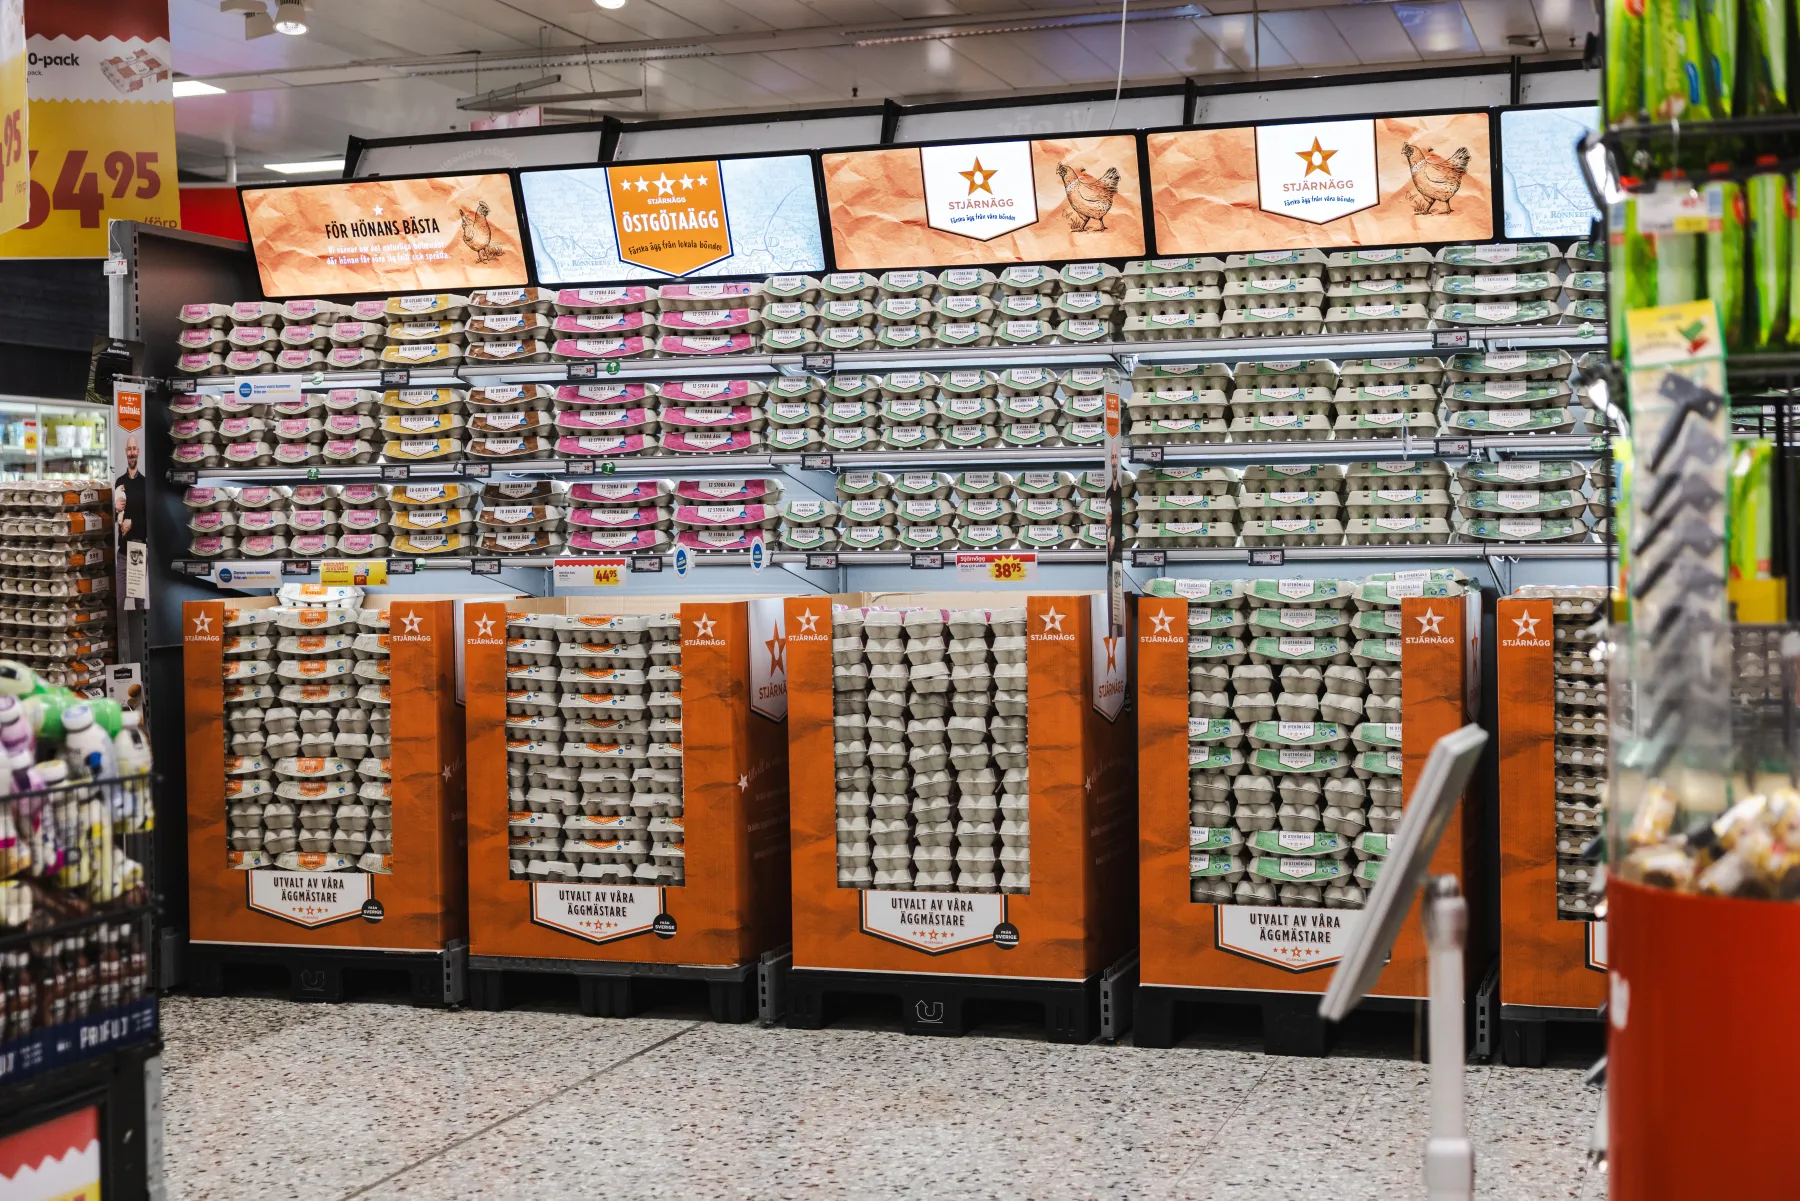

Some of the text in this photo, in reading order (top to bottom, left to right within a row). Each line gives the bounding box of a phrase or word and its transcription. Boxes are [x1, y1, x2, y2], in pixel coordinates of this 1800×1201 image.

[1283, 179, 1354, 192] STJÄRNÄGG
[647, 196, 687, 204] STJÄRNÄGG
[949, 198, 1014, 210] STJÄRNÄGG
[622, 207, 719, 233] ÖSTGÖTAÄGG
[325, 216, 440, 239] FÖR HÖNANS BÄSTA
[392, 634, 431, 642] STJÄRNÄGG
[788, 634, 828, 642] STJÄRNÄGG
[1030, 633, 1075, 642] STJÄRNÄGG
[1140, 636, 1184, 644] STJÄRNÄGG
[1405, 635, 1455, 644] STJÄRNÄGG
[1502, 638, 1550, 647] STJÄRNÄGG
[1099, 681, 1124, 698] STJÄRNÄGG
[273, 876, 345, 890] UTVALT AV VÅRA
[281, 889, 338, 903] ÄGGMÄSTARE
[559, 890, 635, 904] UTVALT AV VÅRA
[567, 903, 628, 918] ÄGGMÄSTARE
[891, 897, 974, 912] UTVALT AV VÅRA
[900, 911, 965, 926] ÄGGMÄSTARE
[1250, 912, 1342, 928] UTVALT AV VÅRA
[1259, 927, 1332, 944] ÄGGMÄSTARE
